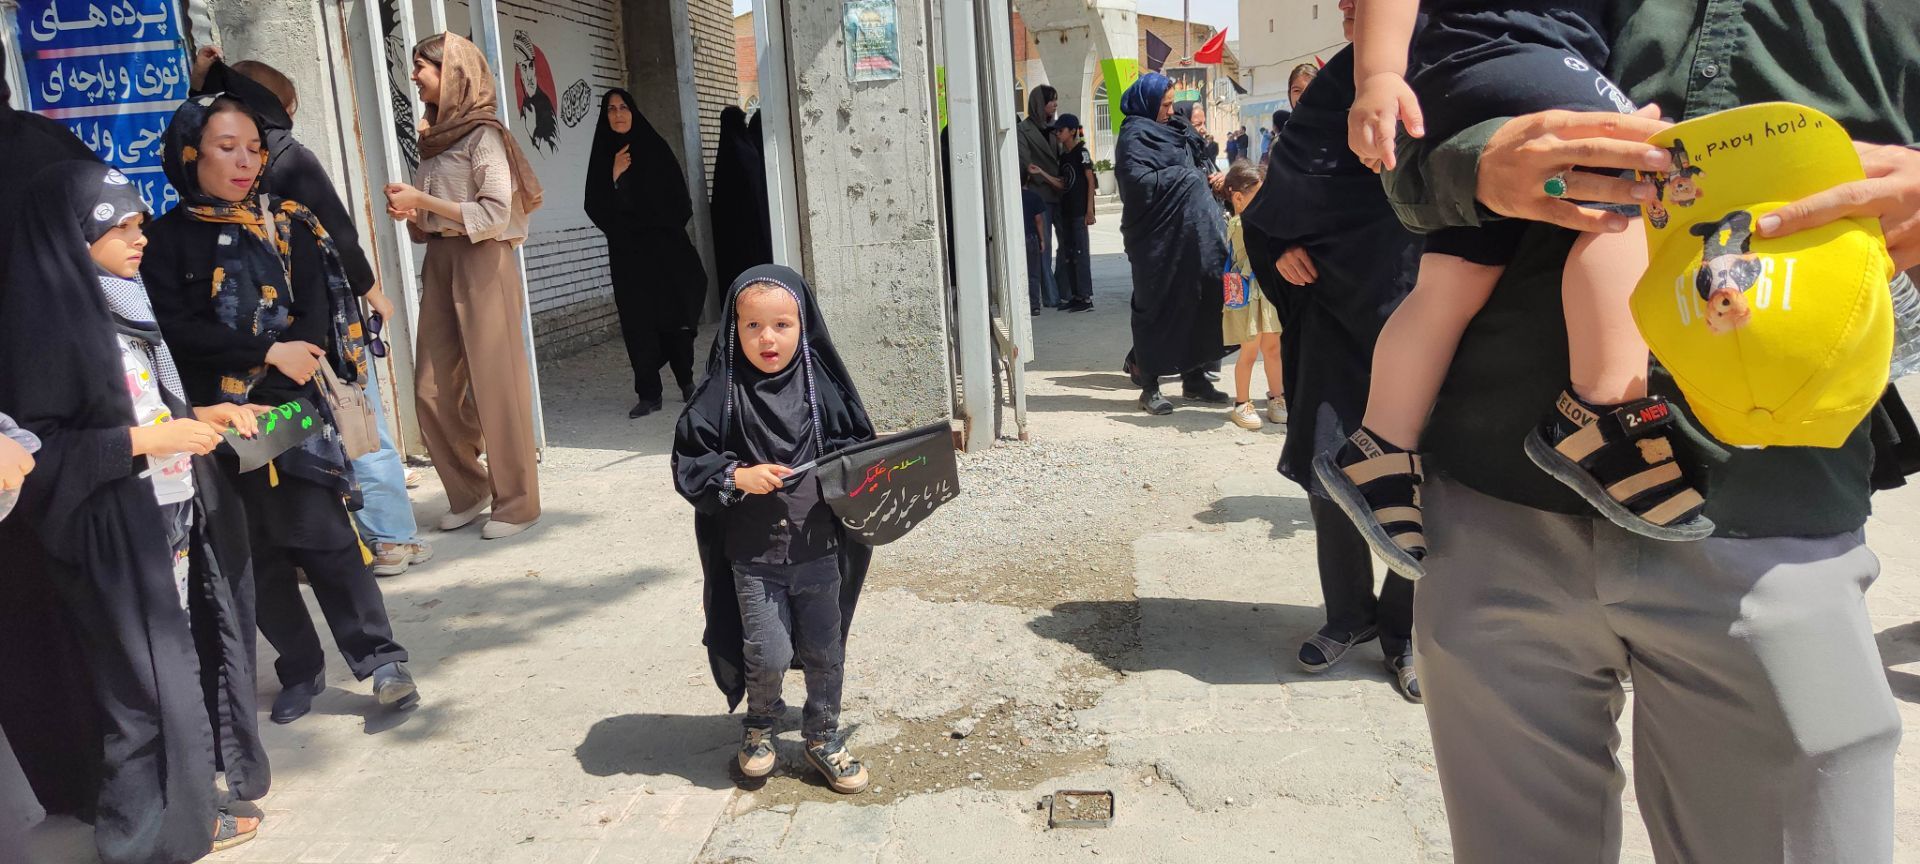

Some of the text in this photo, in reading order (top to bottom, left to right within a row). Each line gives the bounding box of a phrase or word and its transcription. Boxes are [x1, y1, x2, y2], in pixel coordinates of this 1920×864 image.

[31, 0, 168, 42] پرده های
[42, 57, 180, 104] توری و پارچه ای
[1559, 397, 1597, 426] ELOV
[841, 488, 892, 537] حسین
